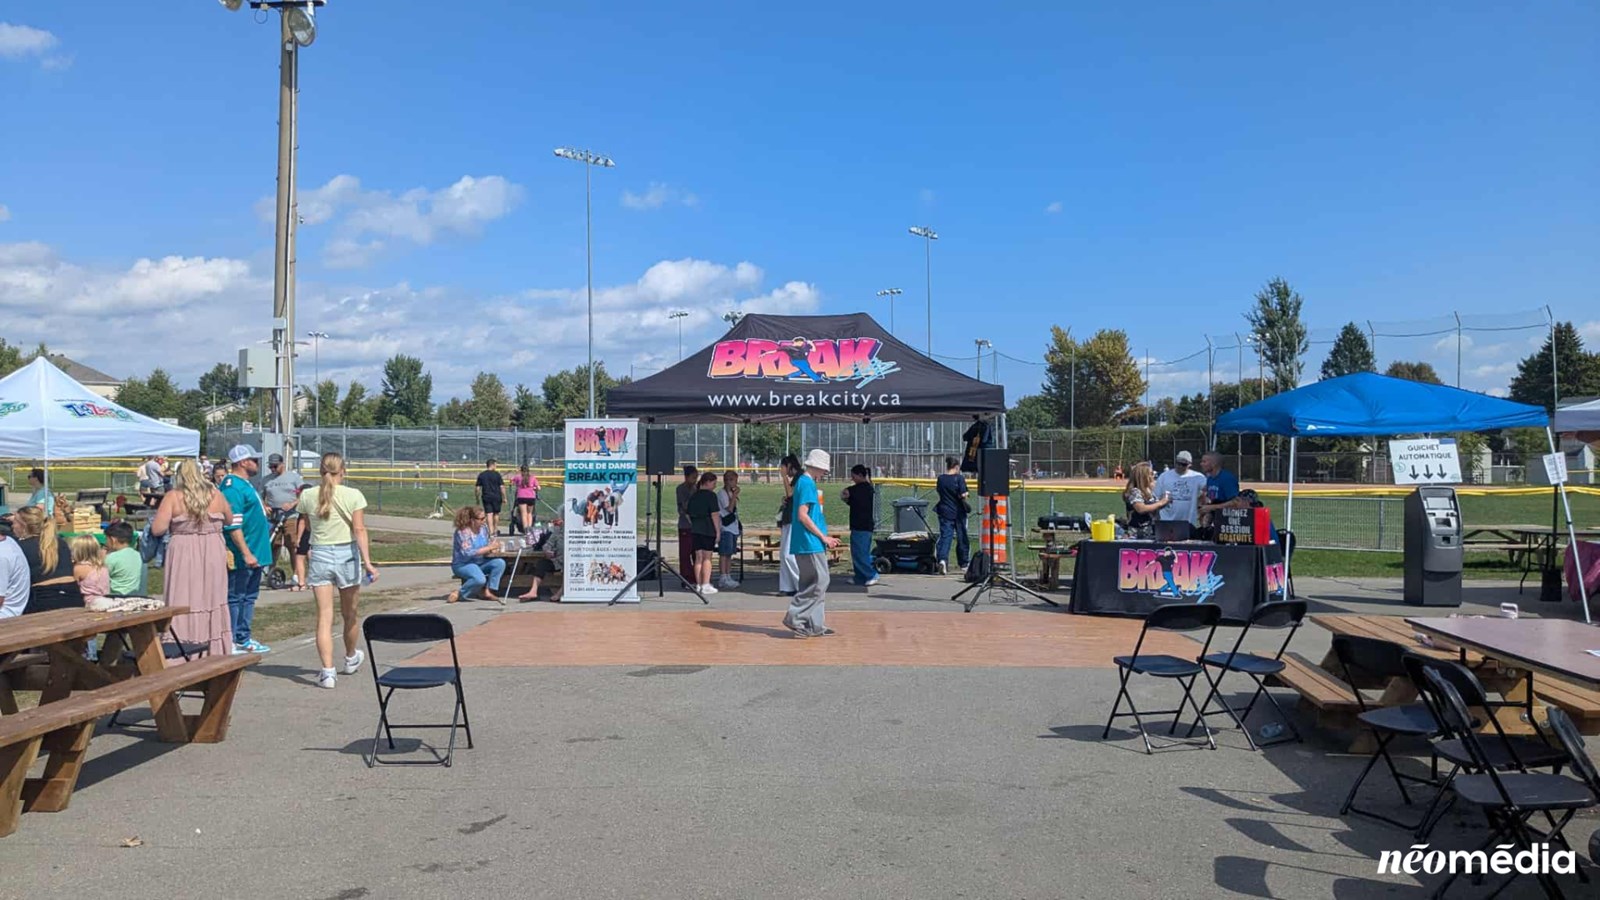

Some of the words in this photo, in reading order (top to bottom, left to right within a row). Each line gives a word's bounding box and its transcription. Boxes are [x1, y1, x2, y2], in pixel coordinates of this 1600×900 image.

[708, 391, 900, 410] www.breakcity.ca
[567, 462, 594, 470] ECOLE
[595, 462, 606, 470] DE
[607, 462, 636, 470] DANSE
[568, 472, 606, 481] BREAK
[609, 472, 635, 481] CITY
[1220, 525, 1250, 534] SESSION
[1219, 533, 1252, 543] GRATUITE
